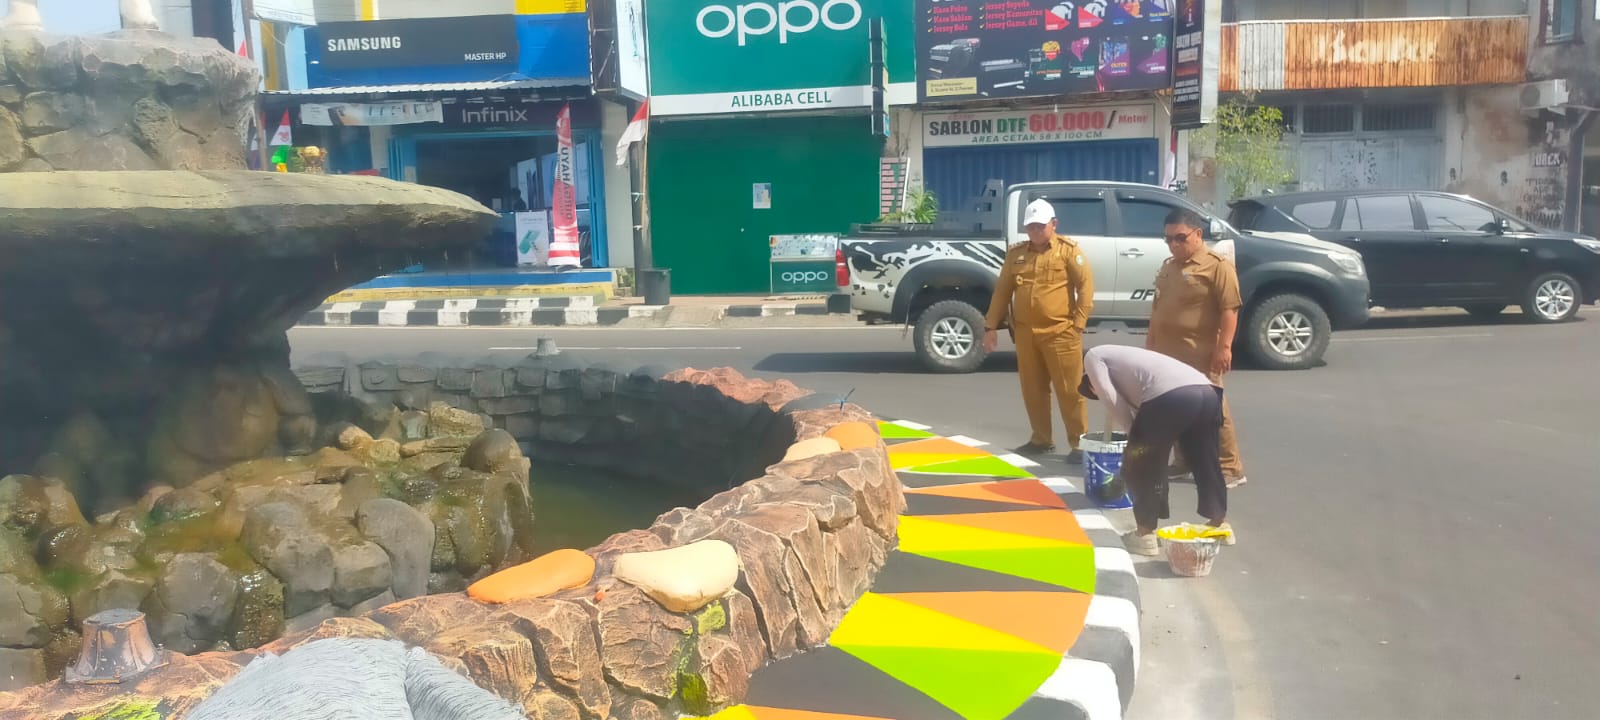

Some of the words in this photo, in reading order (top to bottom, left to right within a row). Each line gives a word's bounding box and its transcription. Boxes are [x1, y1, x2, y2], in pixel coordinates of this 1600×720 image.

[696, 0, 862, 46] oppo
[328, 36, 402, 52] SAMSUNG
[464, 52, 495, 61] MASTER
[495, 51, 506, 60] HP
[731, 93, 794, 108] ALIBABA
[797, 91, 832, 104] CELL
[462, 106, 528, 124] Infinix
[929, 119, 992, 136] SABLON
[996, 117, 1028, 134] DTF
[1118, 114, 1149, 124] Meter
[971, 135, 1000, 144] AREA
[1002, 134, 1036, 142] CETAK
[1055, 132, 1062, 140] X
[1086, 131, 1103, 139] CM
[781, 271, 829, 284] oppo
[1130, 289, 1156, 301] OF
